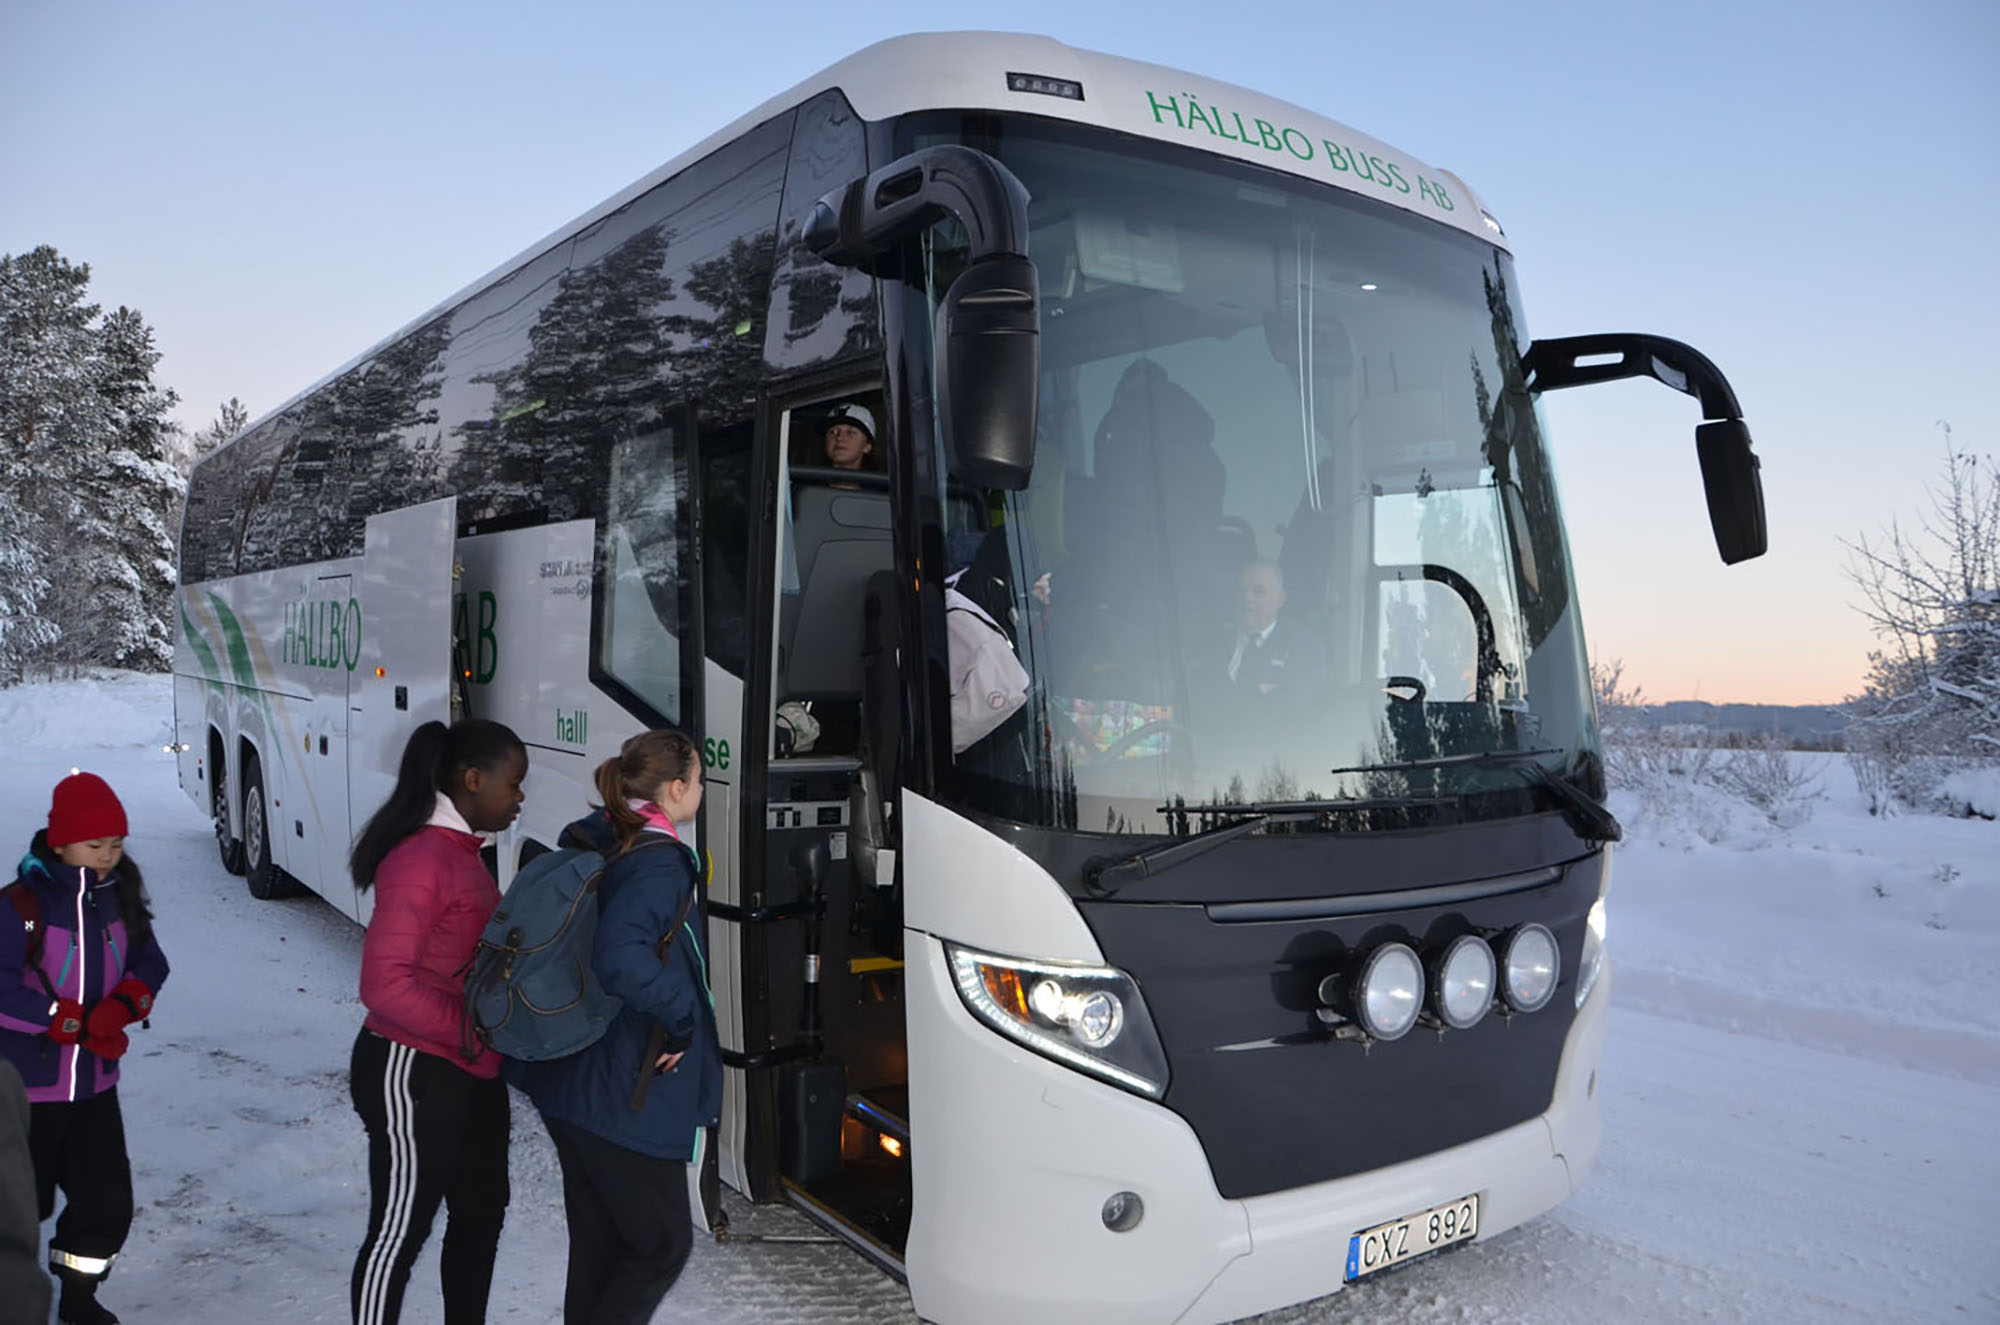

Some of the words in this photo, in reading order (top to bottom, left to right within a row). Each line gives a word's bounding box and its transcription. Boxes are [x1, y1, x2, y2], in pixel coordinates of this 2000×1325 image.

[1145, 91, 1314, 161] HÄLLBO
[1322, 139, 1411, 194] BUSS
[1419, 175, 1455, 212] AB
[283, 584, 362, 672] HÄLLBO
[1363, 1224, 1410, 1267] CXZ
[1428, 1204, 1472, 1244] 892
